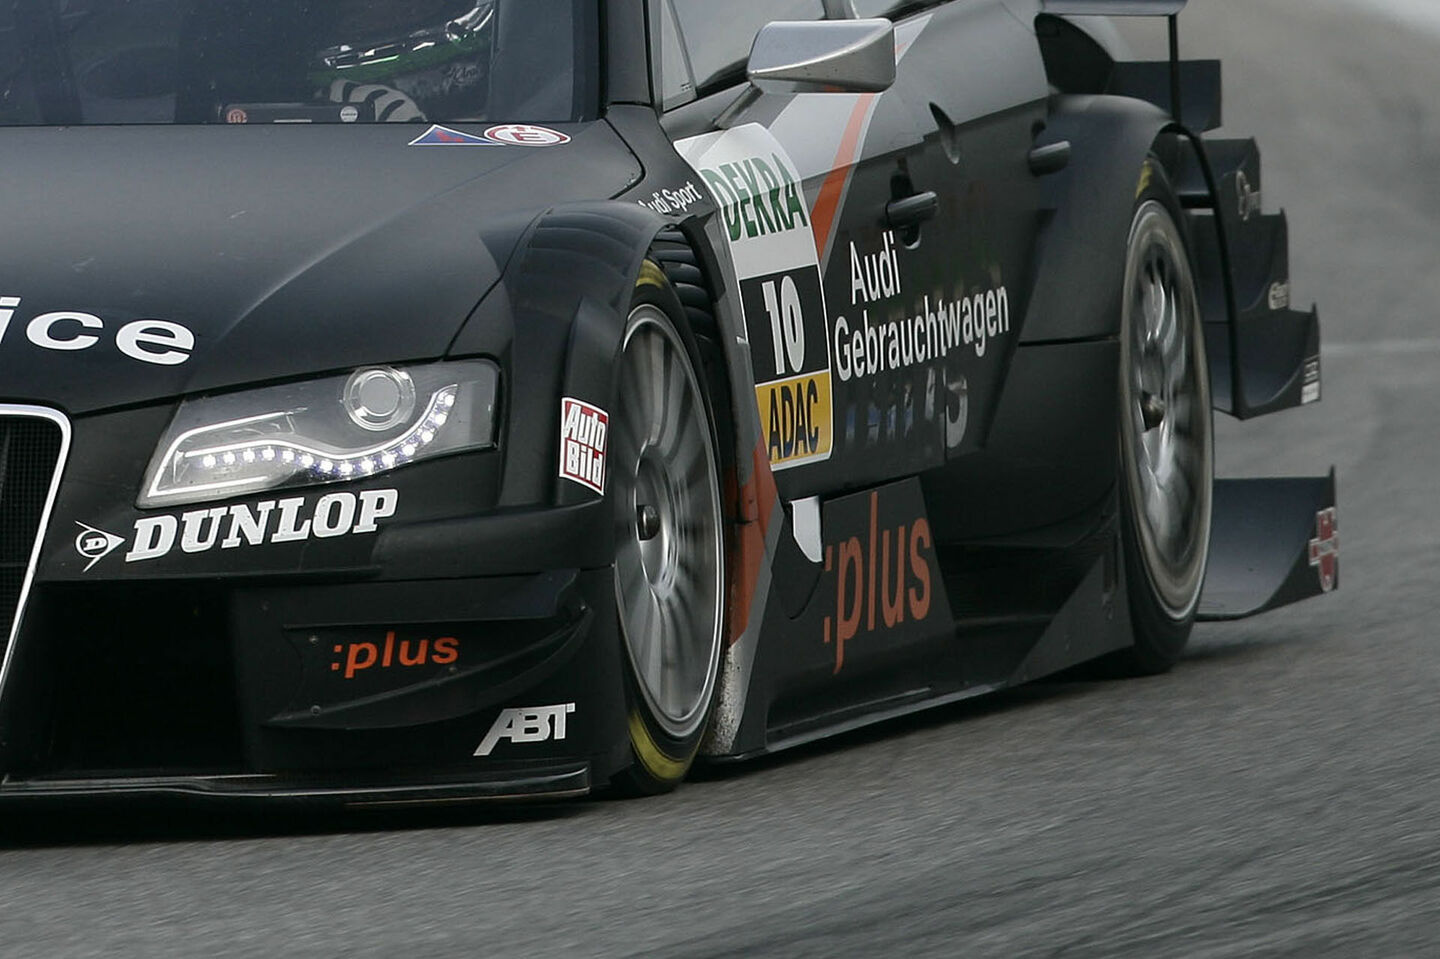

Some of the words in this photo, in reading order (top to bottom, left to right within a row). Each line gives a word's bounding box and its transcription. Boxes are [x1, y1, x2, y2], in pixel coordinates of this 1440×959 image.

[661, 180, 703, 212] Sport
[700, 153, 808, 241] DEKRA
[850, 230, 901, 305] Audi
[762, 275, 805, 375] 10
[834, 286, 1010, 381] Gebrauchtwagen
[563, 403, 606, 453] Auto
[769, 379, 819, 461] ADAC
[565, 440, 603, 488] Bild
[125, 489, 398, 562] DUNLOP
[473, 702, 576, 757] ABT
